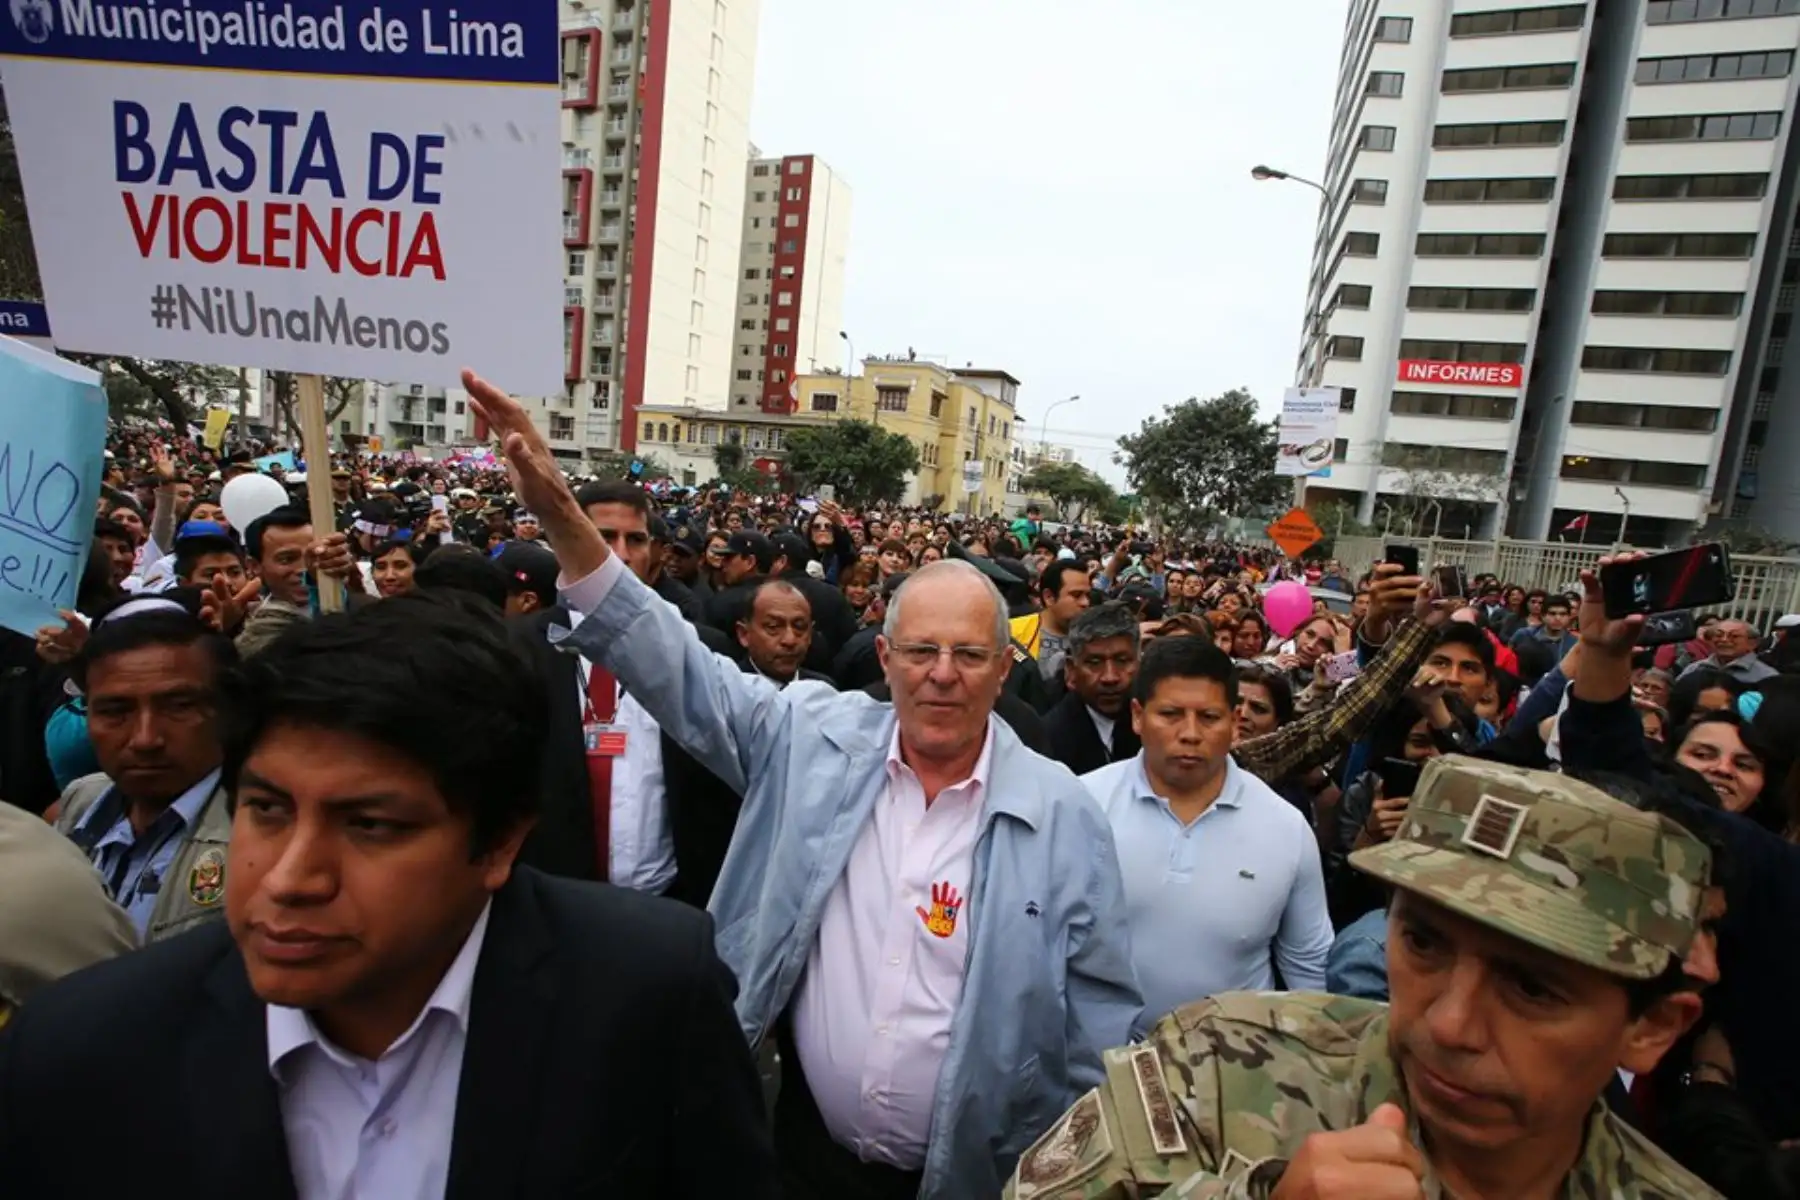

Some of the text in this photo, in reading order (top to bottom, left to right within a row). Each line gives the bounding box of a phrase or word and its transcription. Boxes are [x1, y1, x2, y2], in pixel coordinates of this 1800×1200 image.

[60, 0, 524, 58] Municipalidad de Lima
[113, 100, 445, 204] BASTA DE
[121, 191, 446, 280] VIOLENCIA
[151, 284, 450, 355] #NiUnaMenos
[1407, 362, 1514, 384] INFORMES
